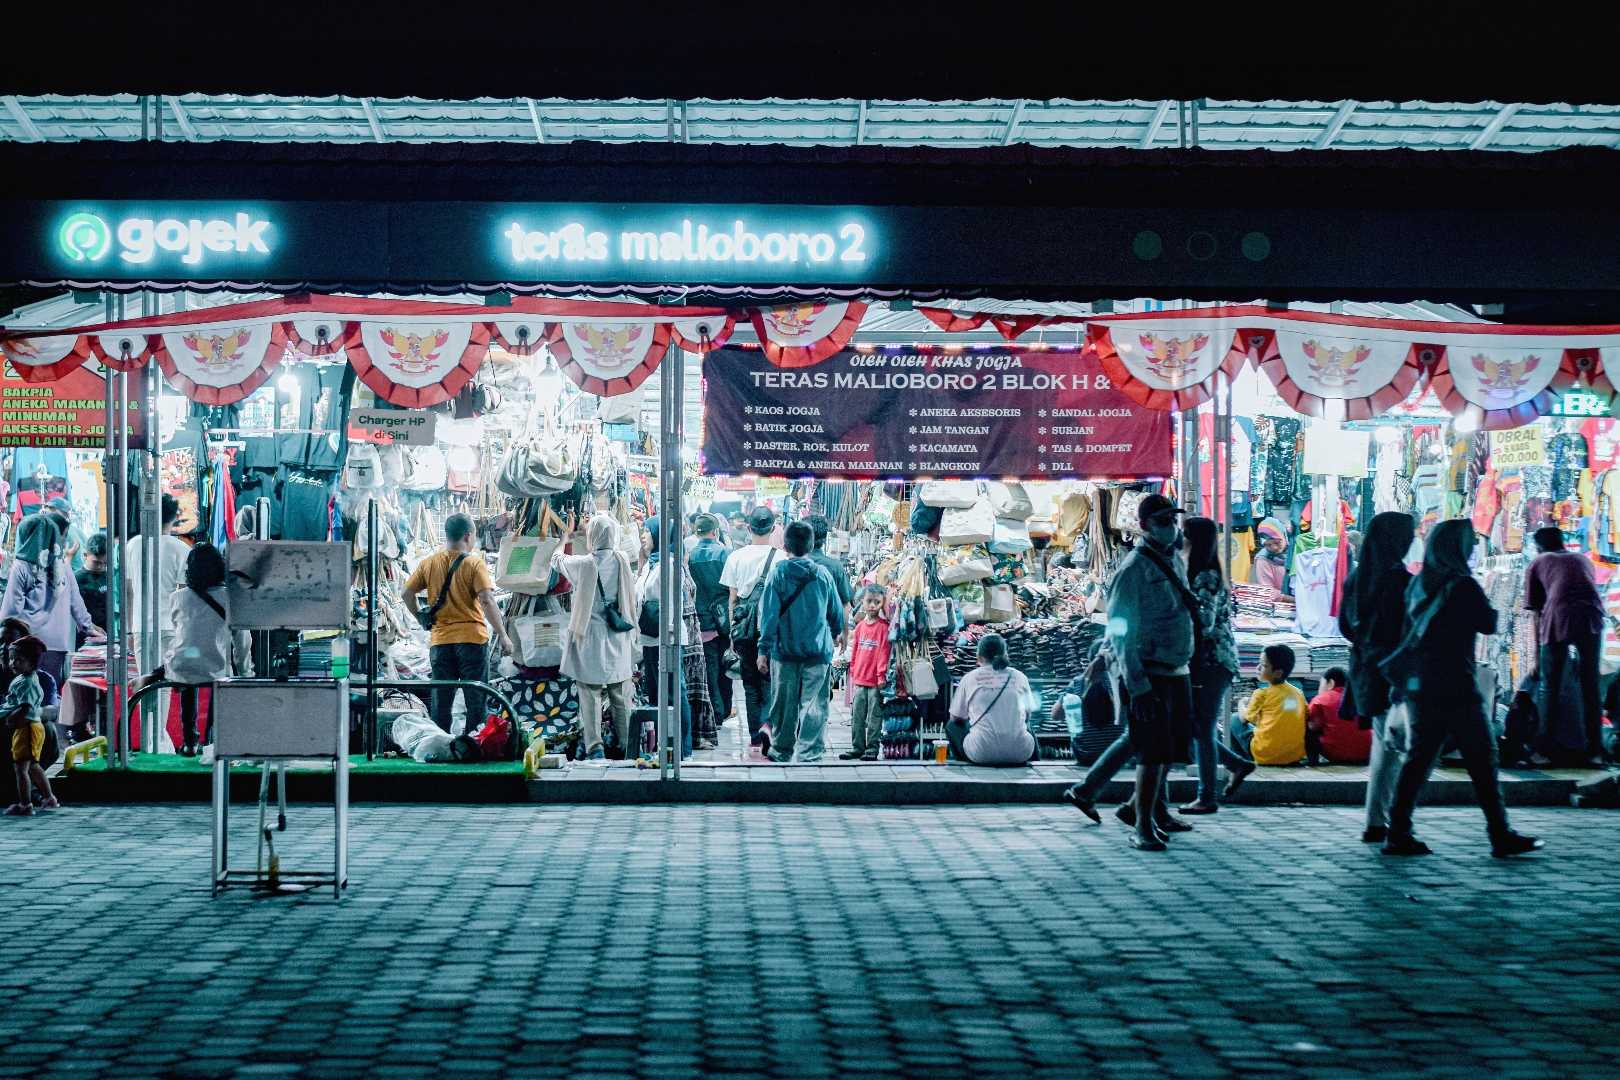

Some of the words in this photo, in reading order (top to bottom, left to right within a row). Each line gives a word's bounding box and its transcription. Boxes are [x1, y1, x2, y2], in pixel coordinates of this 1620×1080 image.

[118, 212, 270, 264] gojek
[504, 222, 608, 261] teras
[621, 219, 836, 261] malioboro
[839, 223, 866, 261] 2
[849, 355, 887, 367] OLEH
[890, 355, 927, 367] OLEH
[931, 355, 972, 368] KHAS
[975, 356, 1023, 371] JOGJA
[750, 372, 828, 389] TERAS
[834, 372, 977, 390] MALIOBORO
[982, 374, 997, 390] 2
[1002, 374, 1067, 390] BLOK
[1072, 374, 1089, 390] H
[1094, 374, 1111, 390] &
[3, 388, 54, 397] BAKPIA
[2, 399, 49, 409] ANEKA
[754, 406, 784, 415] KAOS
[786, 406, 821, 416] JOGJA
[920, 408, 957, 417] ANEKA
[959, 408, 1021, 417] AKSESORIS
[1051, 409, 1095, 417] SANDAL
[1097, 409, 1132, 417] JOGJA
[2, 412, 77, 421] MINUMAN
[358, 415, 406, 427] Charger
[409, 417, 426, 426] HP
[2, 425, 81, 435] AKSESORIS
[754, 423, 788, 432] BATIK
[790, 424, 824, 433] JOGJA
[919, 425, 942, 434] JAM
[944, 426, 990, 435] TANGAN
[1051, 427, 1094, 435] SURJAN
[374, 430, 385, 439] di
[387, 430, 409, 440] Sini
[1496, 429, 1537, 444] OBRAL
[1, 436, 31, 445] DAN
[754, 441, 801, 452] DASTER,
[803, 442, 830, 452] ROK,
[832, 443, 870, 452] KULOT
[919, 444, 978, 453] KACAMATA
[1051, 444, 1072, 453] TAS
[1074, 445, 1083, 453] &
[1086, 443, 1133, 453] DOMPET
[754, 459, 794, 468] BAKPIA
[797, 460, 806, 469] &
[807, 460, 846, 470] ANEKA
[848, 461, 903, 470] MAKANAN
[919, 462, 981, 471] BLANGKON
[1051, 462, 1074, 471] DLL
